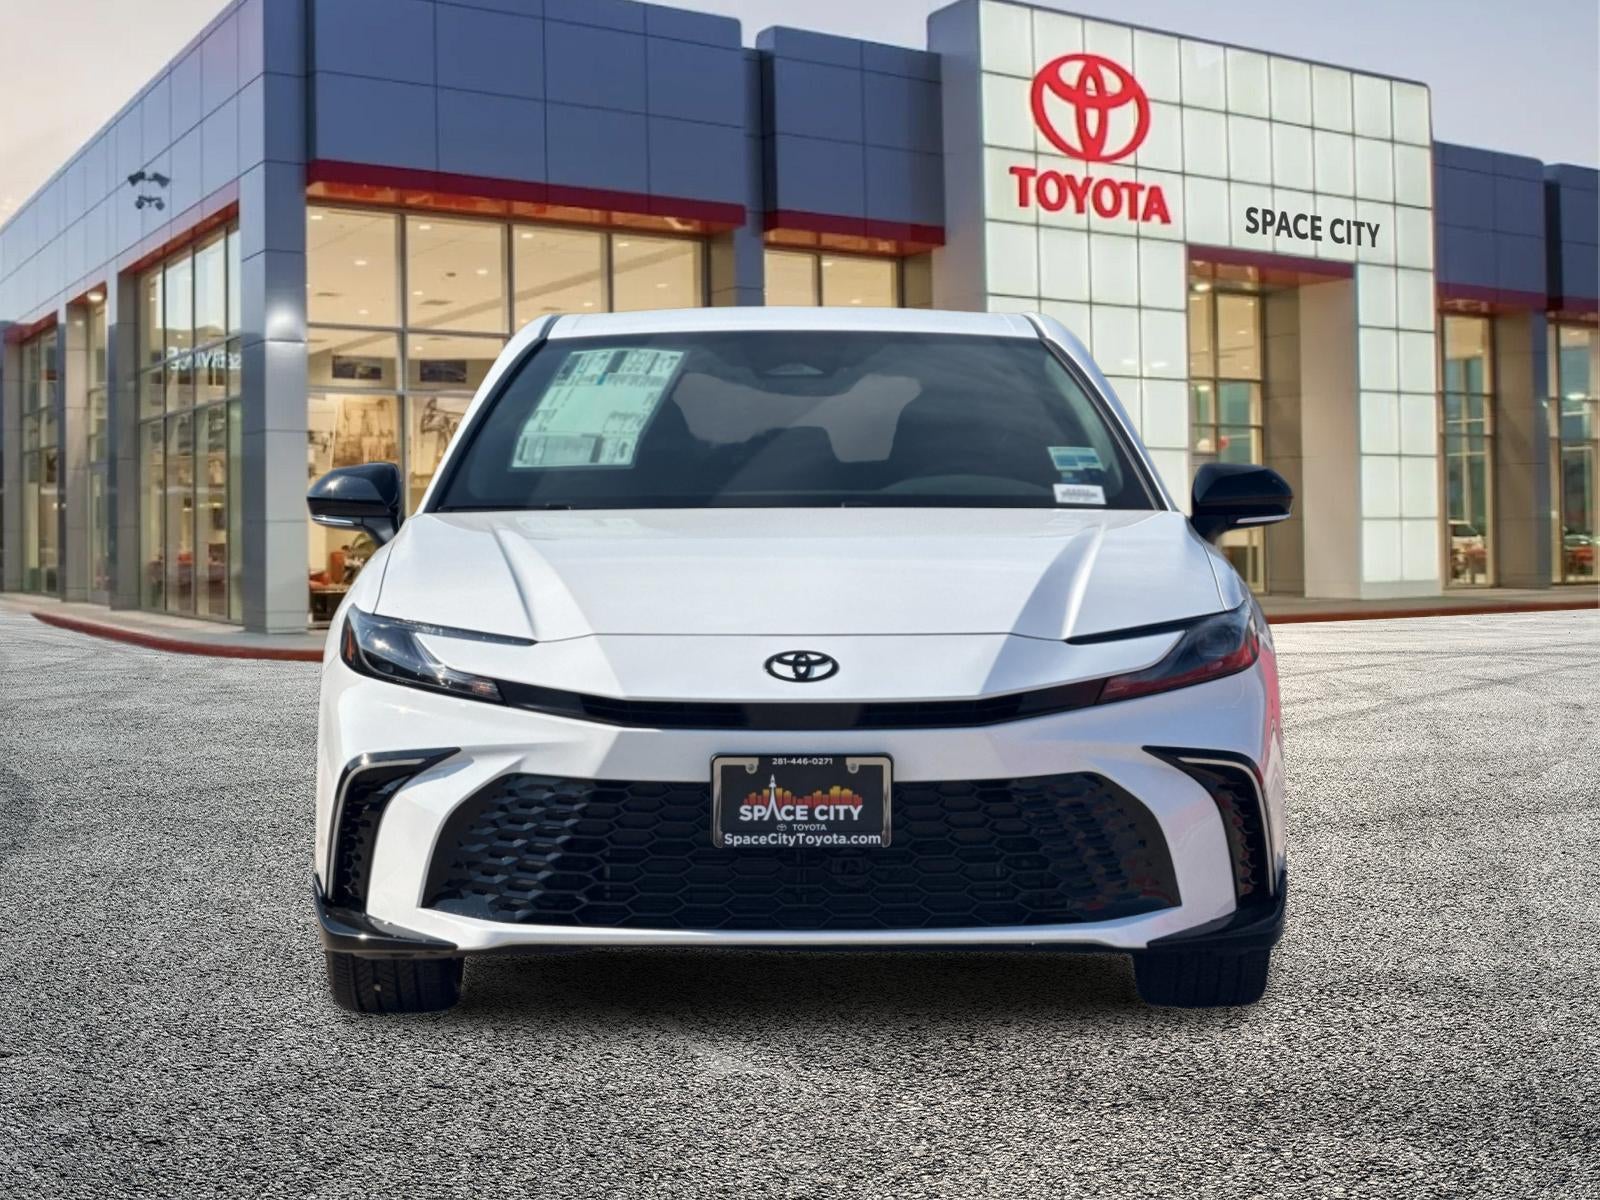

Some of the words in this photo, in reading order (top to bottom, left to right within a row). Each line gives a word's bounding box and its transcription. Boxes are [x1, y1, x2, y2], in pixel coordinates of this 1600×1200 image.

[1009, 166, 1171, 224] TOYOTA
[1245, 207, 1322, 241] SPACE
[1330, 218, 1380, 248] CITY
[772, 757, 833, 766] 281-446-0271
[739, 797, 809, 822] SPACE
[814, 804, 863, 821] CITY
[724, 833, 881, 847] SpaceCityToyota.com
